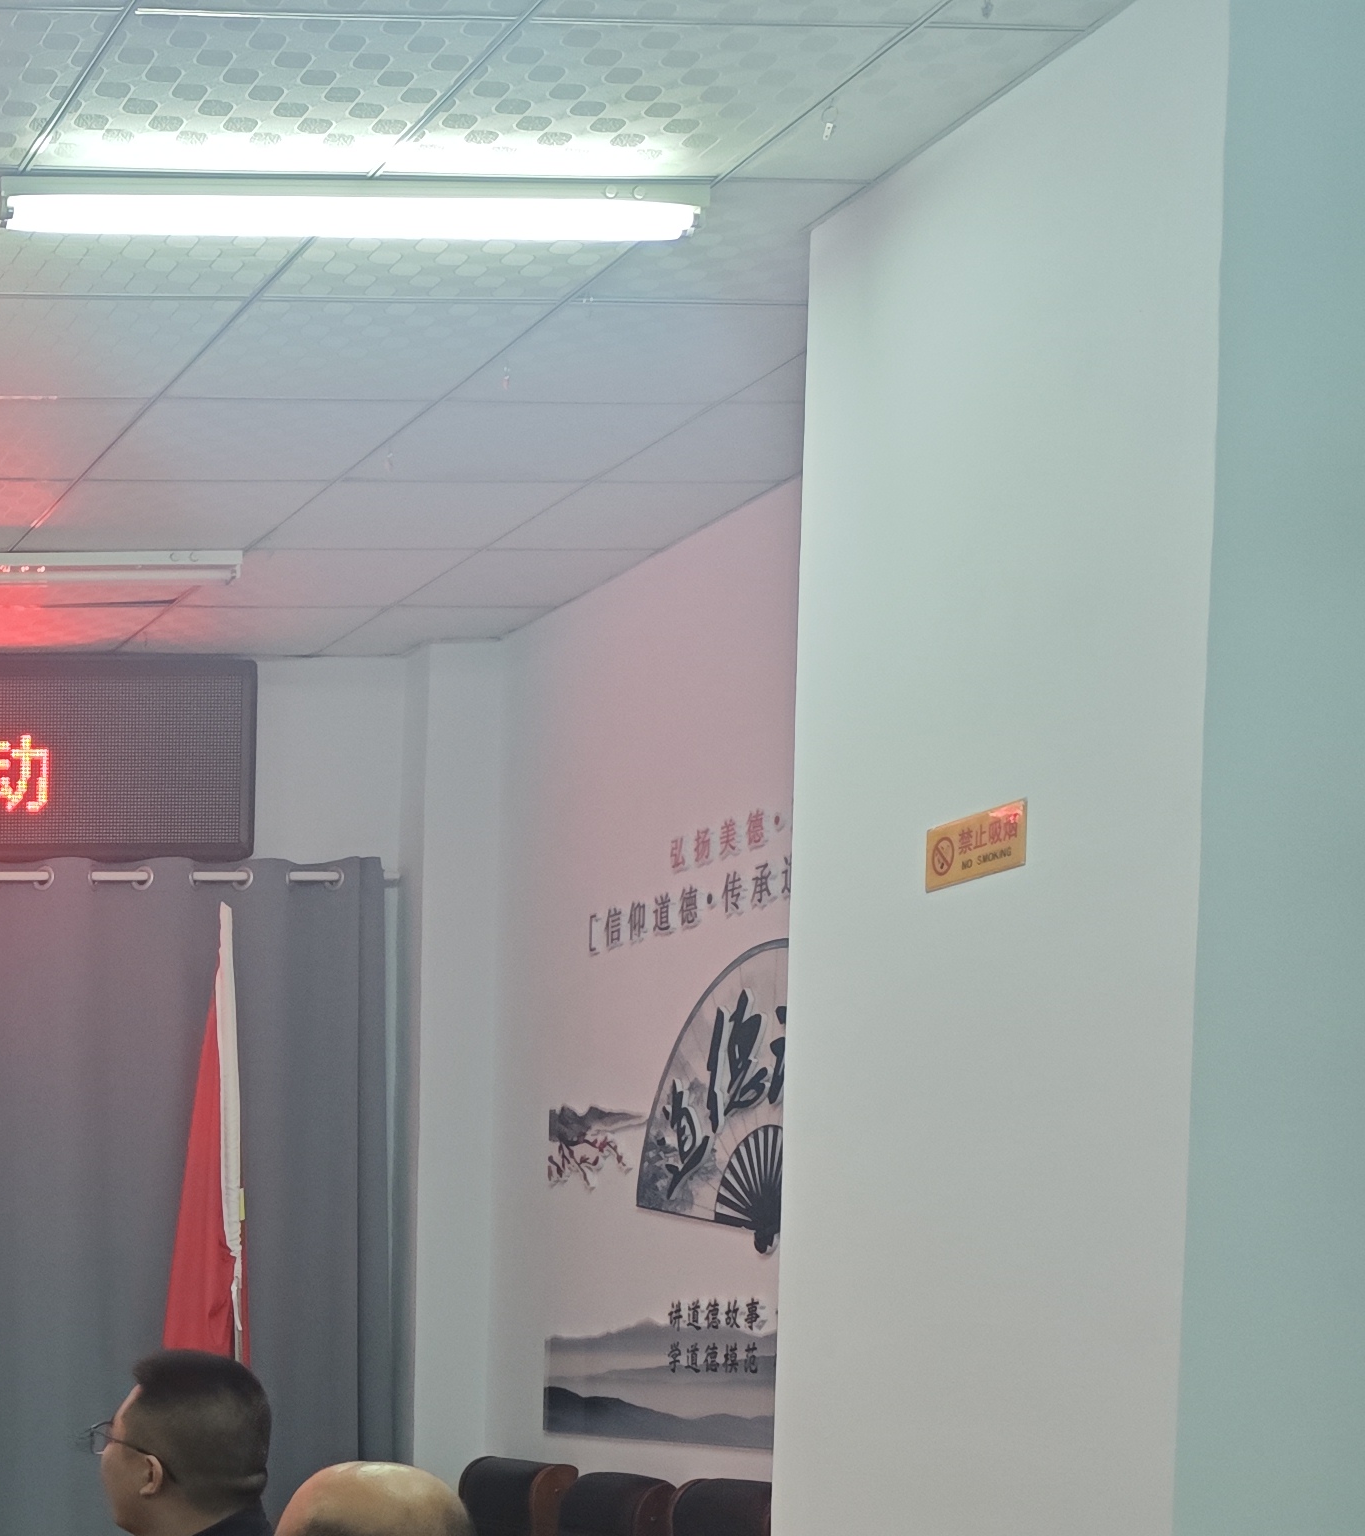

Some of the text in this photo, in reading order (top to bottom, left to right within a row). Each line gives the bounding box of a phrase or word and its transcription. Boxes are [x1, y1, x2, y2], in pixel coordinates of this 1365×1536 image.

[958, 812, 1020, 856] 禁止吸烟
[961, 846, 1012, 871] NO SMOKING
[668, 1298, 760, 1331] 讲道德故事
[668, 1341, 758, 1373] 学道德模范
